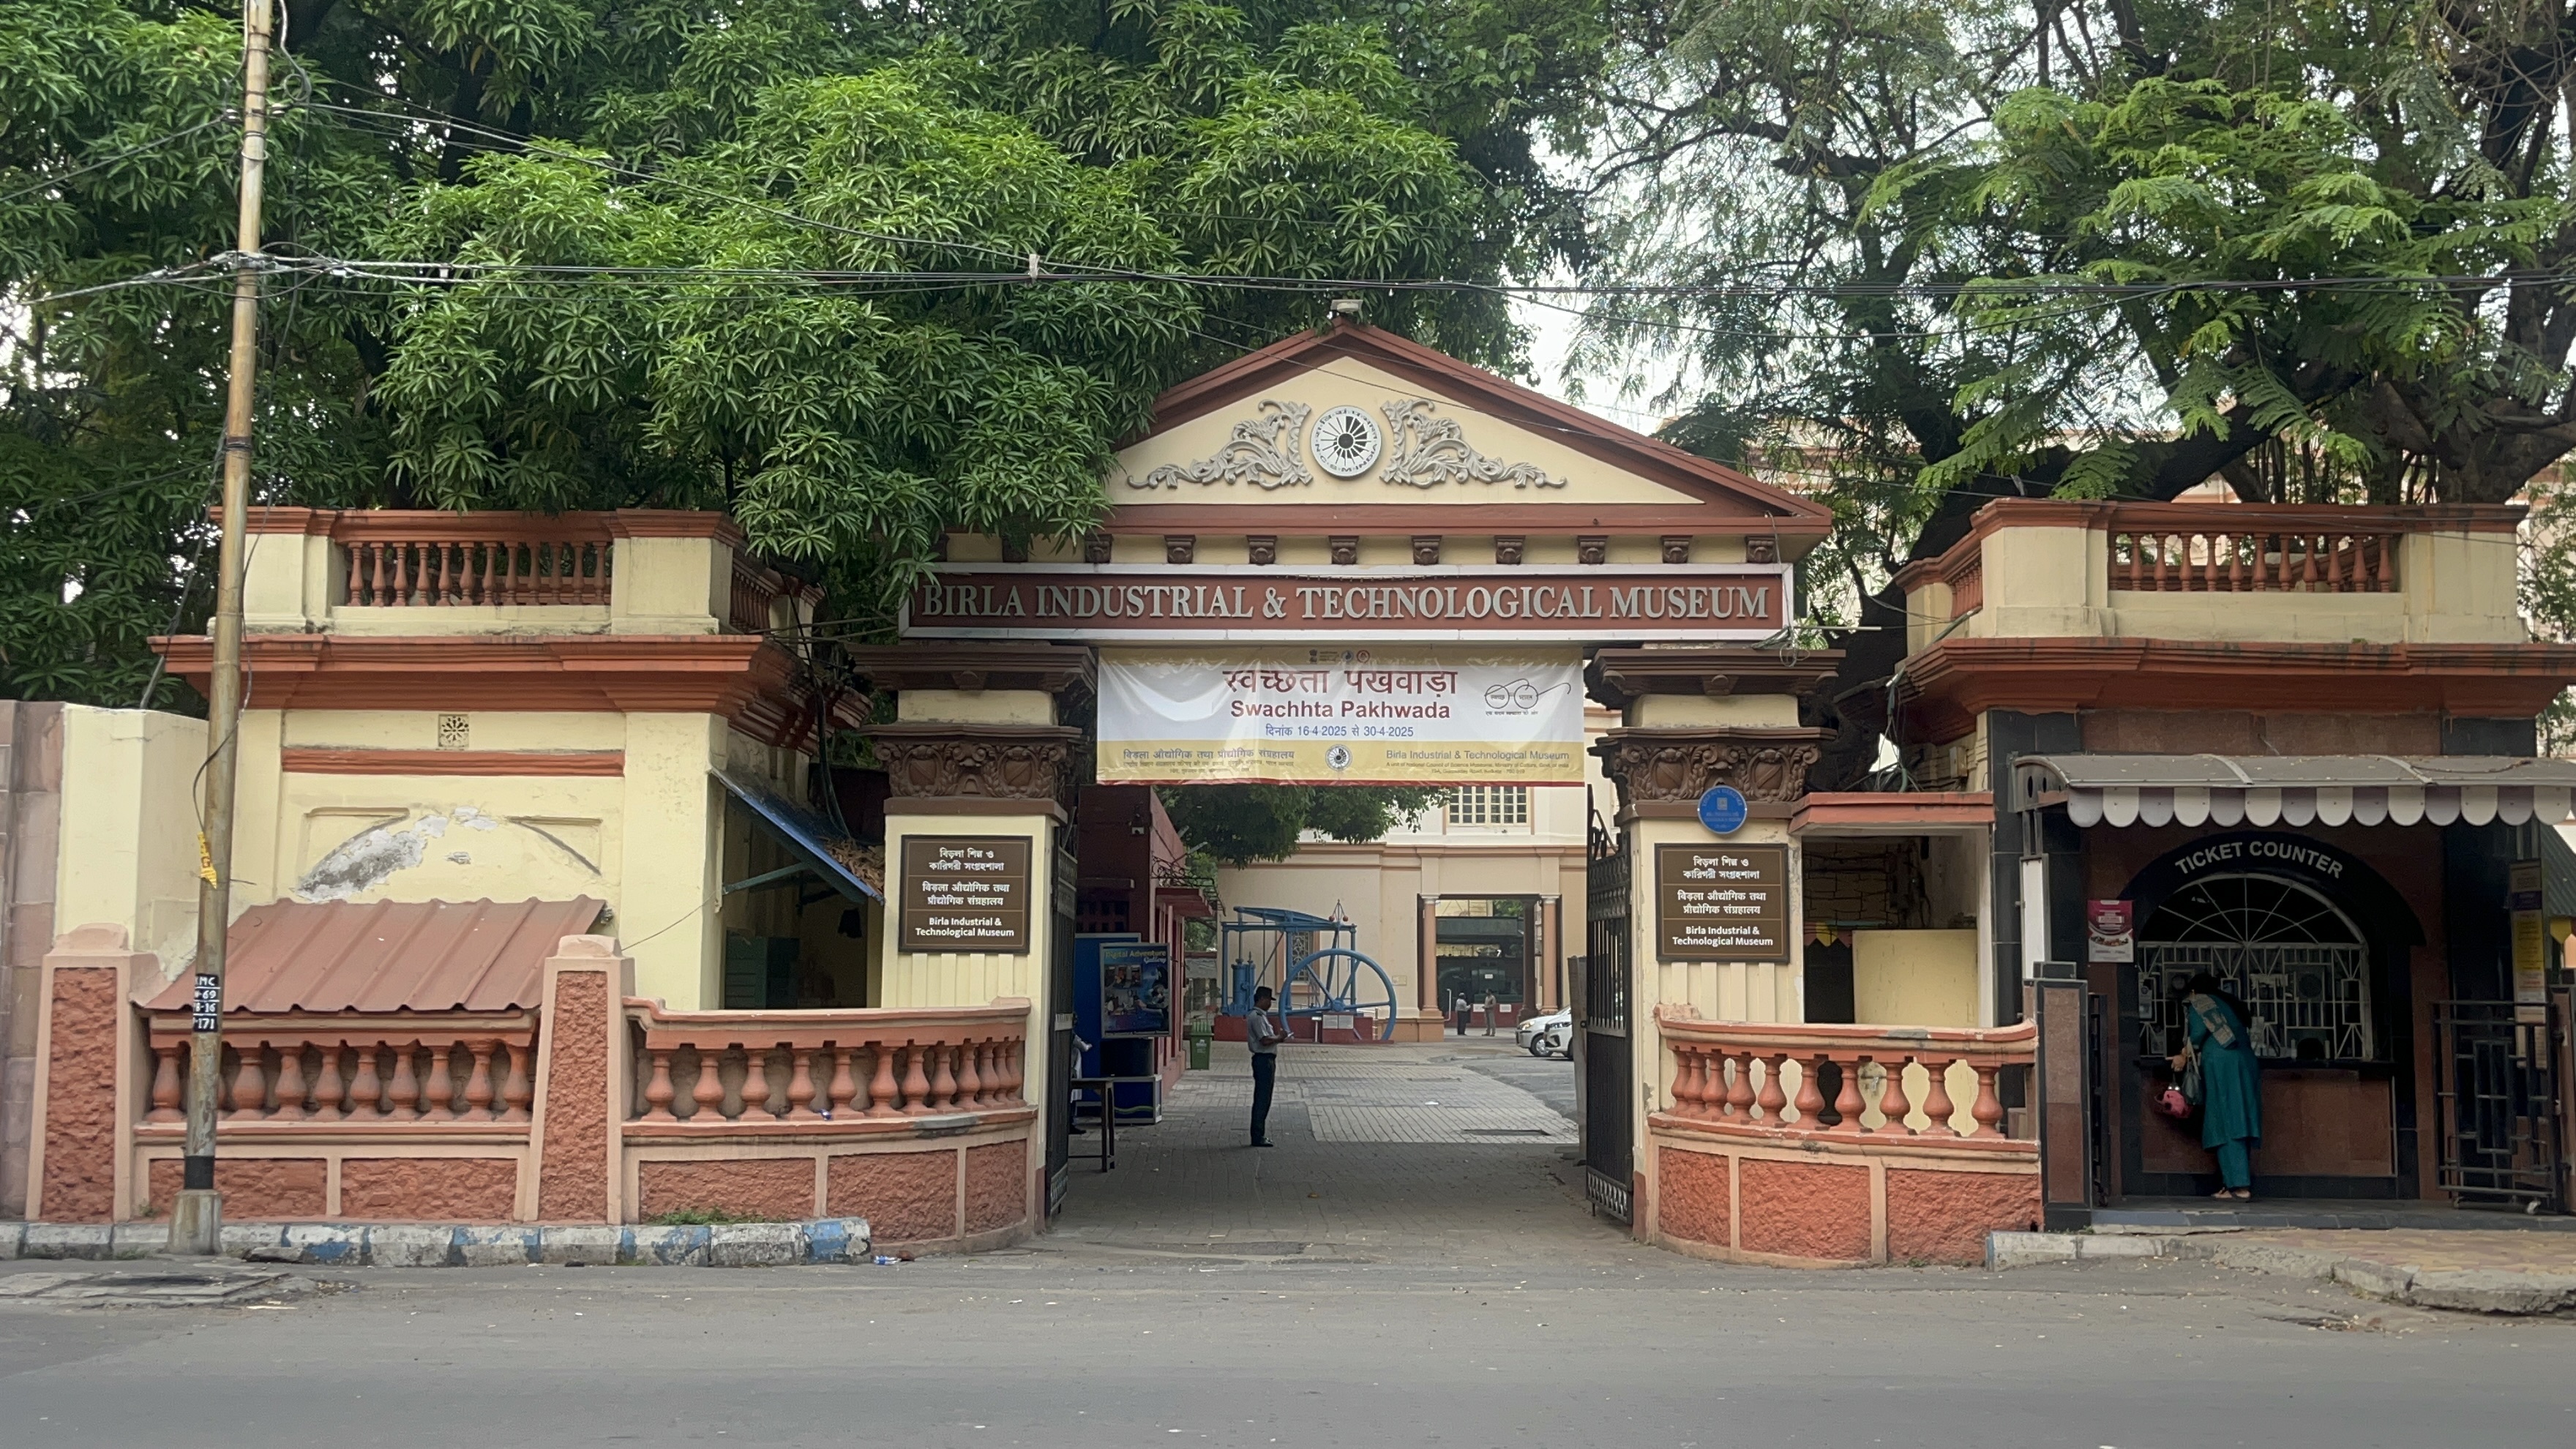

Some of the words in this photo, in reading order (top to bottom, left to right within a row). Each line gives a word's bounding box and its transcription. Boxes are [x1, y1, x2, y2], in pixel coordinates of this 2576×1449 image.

[922, 585, 1025, 617] BIRLA
[1036, 585, 1254, 618] INDUSTRIAL
[1262, 586, 1287, 618] &
[1296, 586, 1602, 618] TECHNOLOGICAL
[1609, 586, 1769, 618] MUSEUM
[1222, 670, 1330, 694] स्वच्छता
[1344, 670, 1459, 697] पखवाड़ा
[1231, 700, 1333, 718] Swachhta
[1341, 700, 1450, 719] Pakhwada
[1265, 723, 1293, 736] दिनांक
[1298, 725, 1347, 736] 16-4-2025
[1352, 724, 1360, 736] से
[1363, 726, 1414, 737] 30-4-2025
[1386, 750, 1407, 759] Birla
[1410, 750, 1451, 760] Industrial
[1454, 751, 1461, 759] &
[1464, 750, 1527, 762] Technological
[1530, 751, 1569, 760] Museum
[940, 847, 964, 859] বিড়লা
[986, 850, 994, 858] ও
[1693, 855, 1718, 867] বিড়লা
[1741, 858, 1749, 866] ও
[2175, 842, 2242, 874] TICKET
[2250, 841, 2343, 879] COUNTER
[993, 883, 1010, 892] तथा
[967, 895, 1003, 906] संग्रहालय
[1749, 892, 1767, 901] तथा
[1723, 904, 1761, 915] संग्रहालय
[929, 917, 948, 926] Birla
[951, 917, 992, 926] Industrial
[994, 918, 1002, 926] &
[916, 928, 976, 938] Technological
[977, 929, 1014, 937] Museum
[1685, 926, 1706, 935] Birla
[1708, 926, 1751, 935] Industrial
[1753, 926, 1760, 935] &
[1672, 937, 1733, 947] Technological
[1735, 937, 1773, 946] Museum
